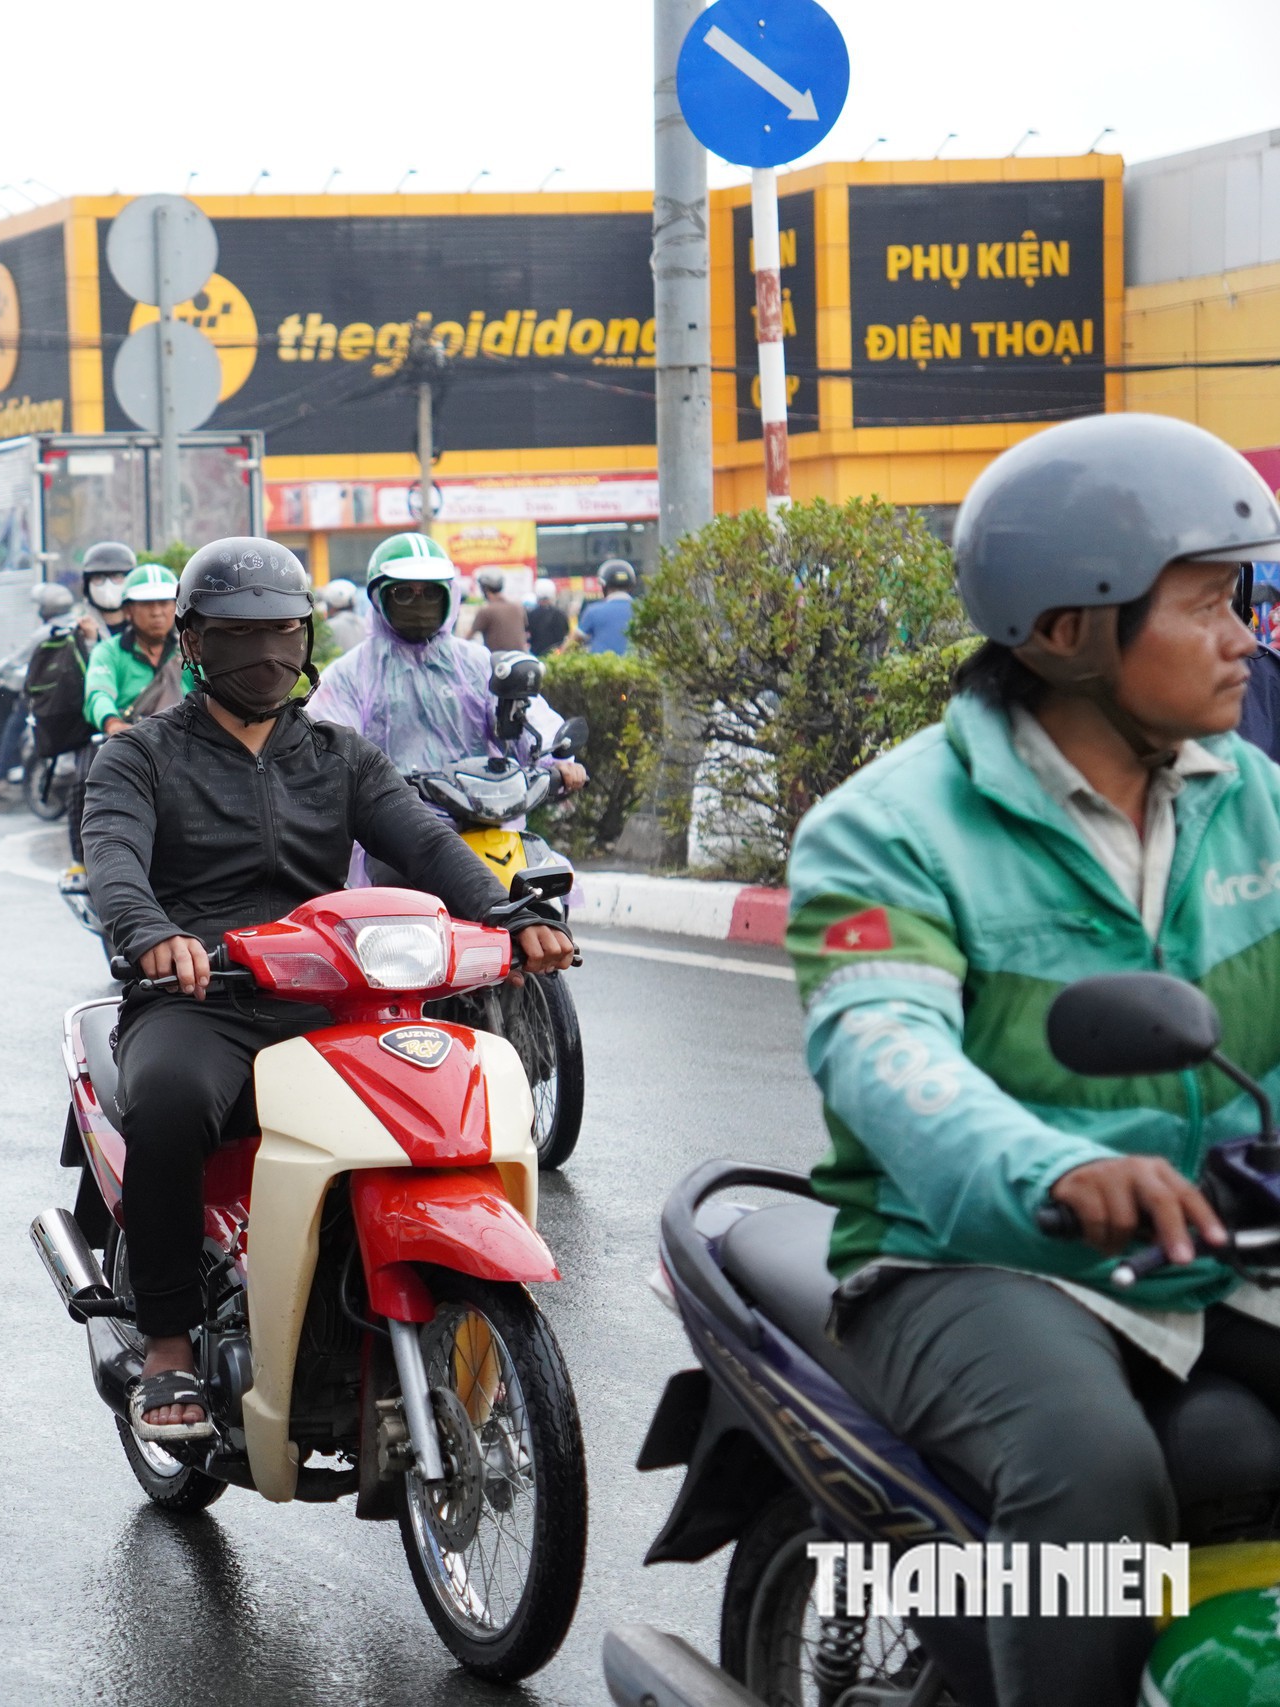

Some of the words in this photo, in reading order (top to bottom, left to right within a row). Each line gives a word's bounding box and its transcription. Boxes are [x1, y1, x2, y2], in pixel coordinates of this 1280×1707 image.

[886, 243, 969, 290] PHỤ
[977, 229, 1070, 288] KIỆN
[865, 314, 962, 371] ĐIỆN
[971, 318, 1094, 366] THOẠI
[395, 1030, 440, 1040] SUZUKI
